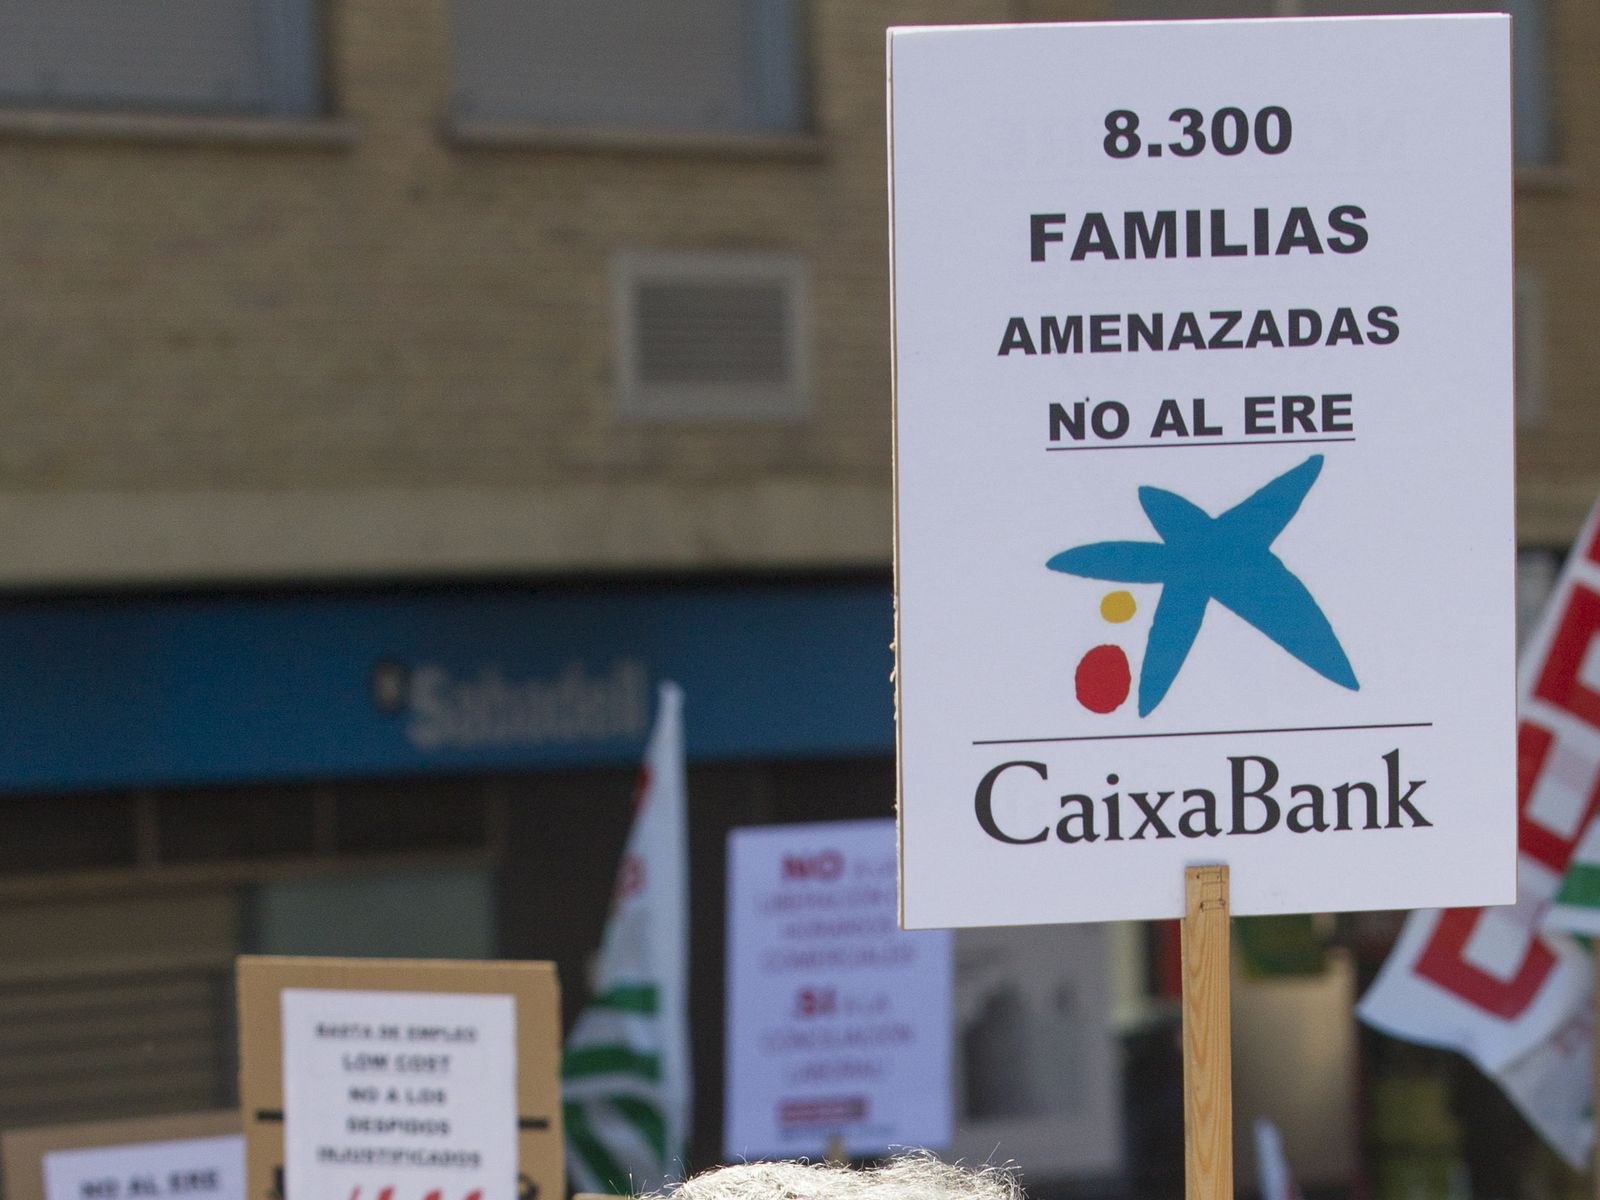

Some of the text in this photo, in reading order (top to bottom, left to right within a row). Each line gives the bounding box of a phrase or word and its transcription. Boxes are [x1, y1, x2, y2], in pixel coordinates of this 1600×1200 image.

[1102, 106, 1293, 159] 8.300
[1030, 205, 1369, 262] FAMILIAS
[997, 306, 1400, 356] AMENAZADAS
[1048, 393, 1354, 442] NO AL ERE
[974, 748, 1434, 845] CaixaBank
[395, 1053, 450, 1073] COST
[349, 1085, 447, 1105] NO A LOS
[346, 1116, 450, 1136] DESPIDOS
